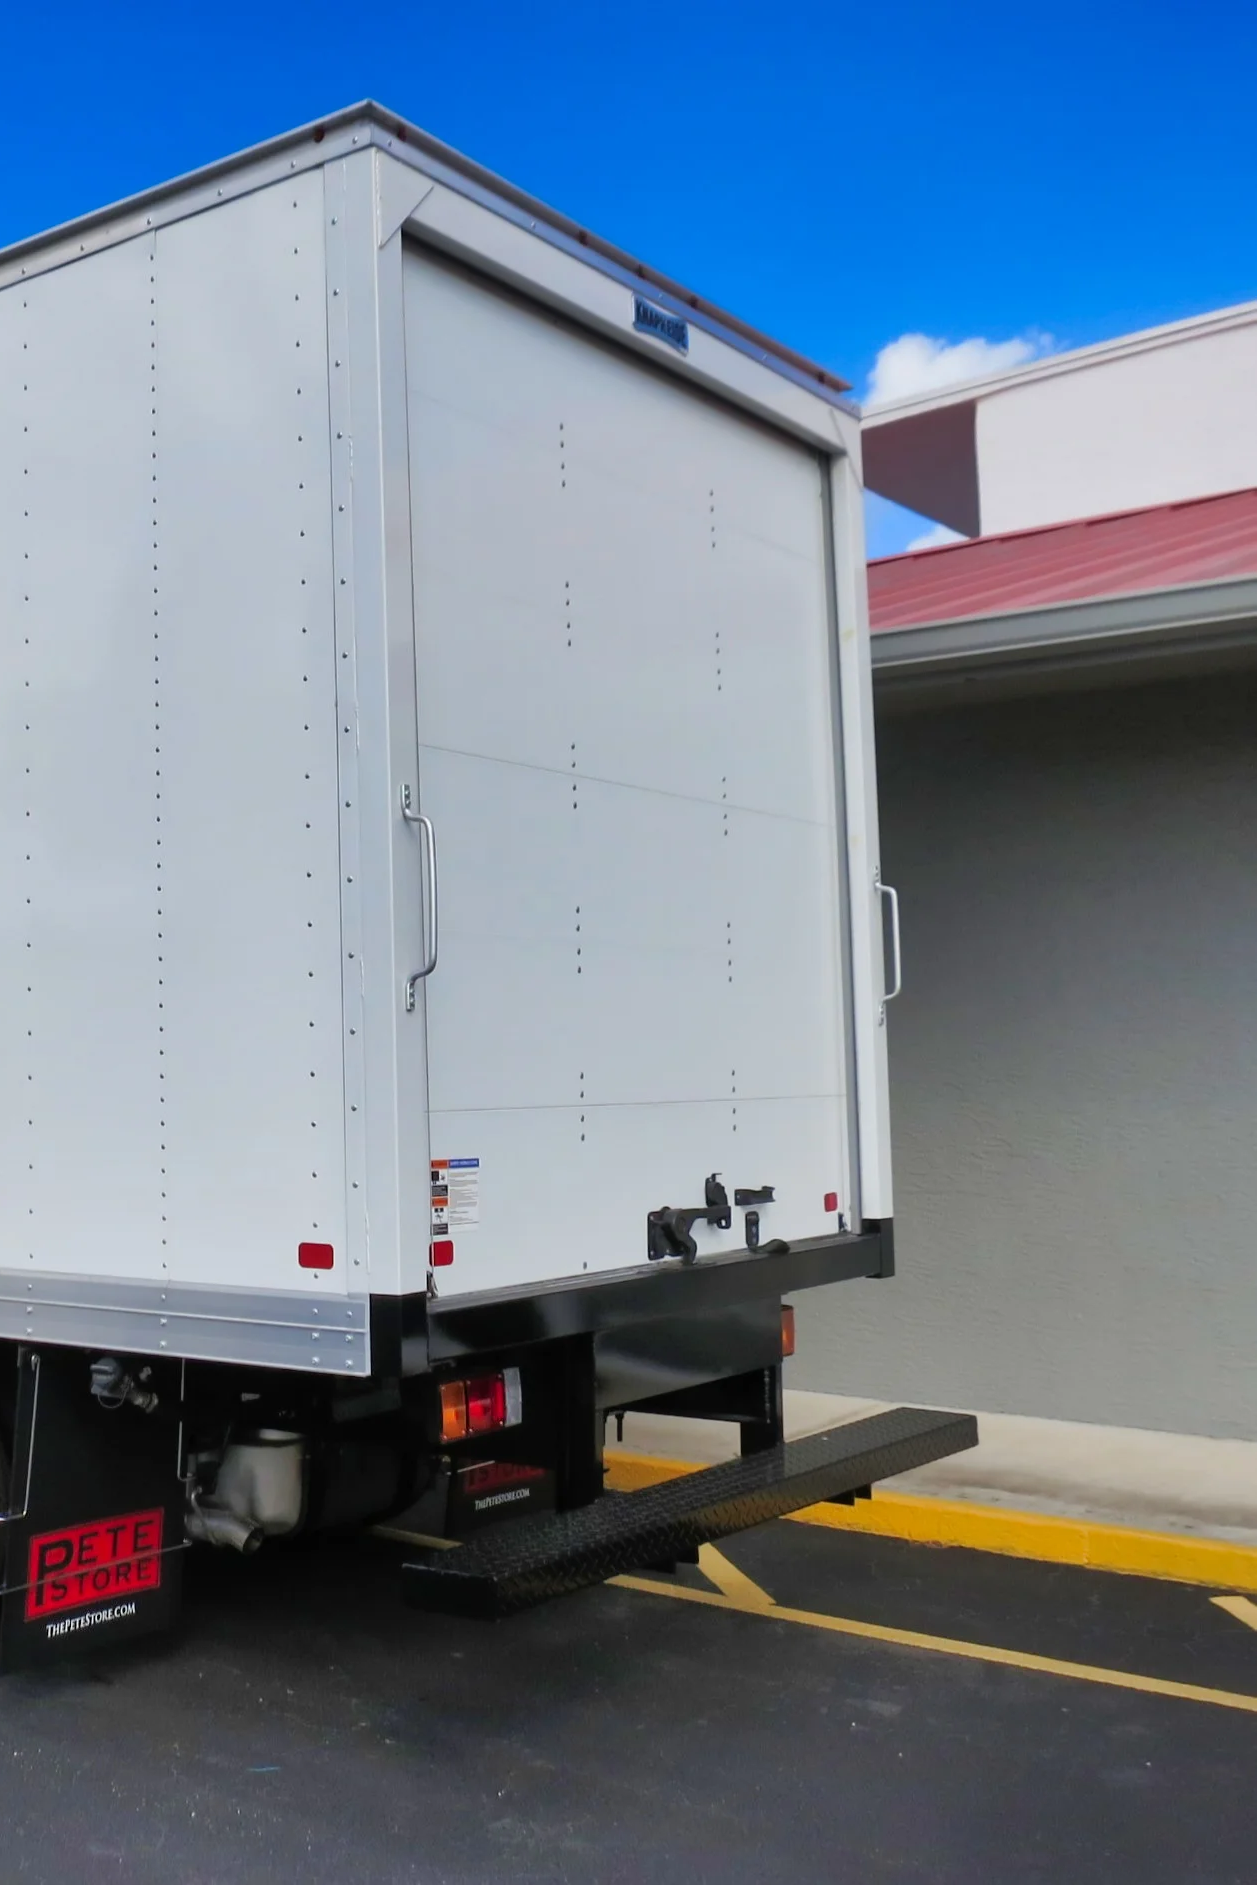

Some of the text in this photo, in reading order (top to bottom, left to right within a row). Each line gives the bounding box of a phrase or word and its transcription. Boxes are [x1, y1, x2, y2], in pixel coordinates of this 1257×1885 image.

[36, 1521, 154, 1606] PETE
[50, 1557, 152, 1602] STORE
[45, 1602, 136, 1638] THEPETESTORE.COM
